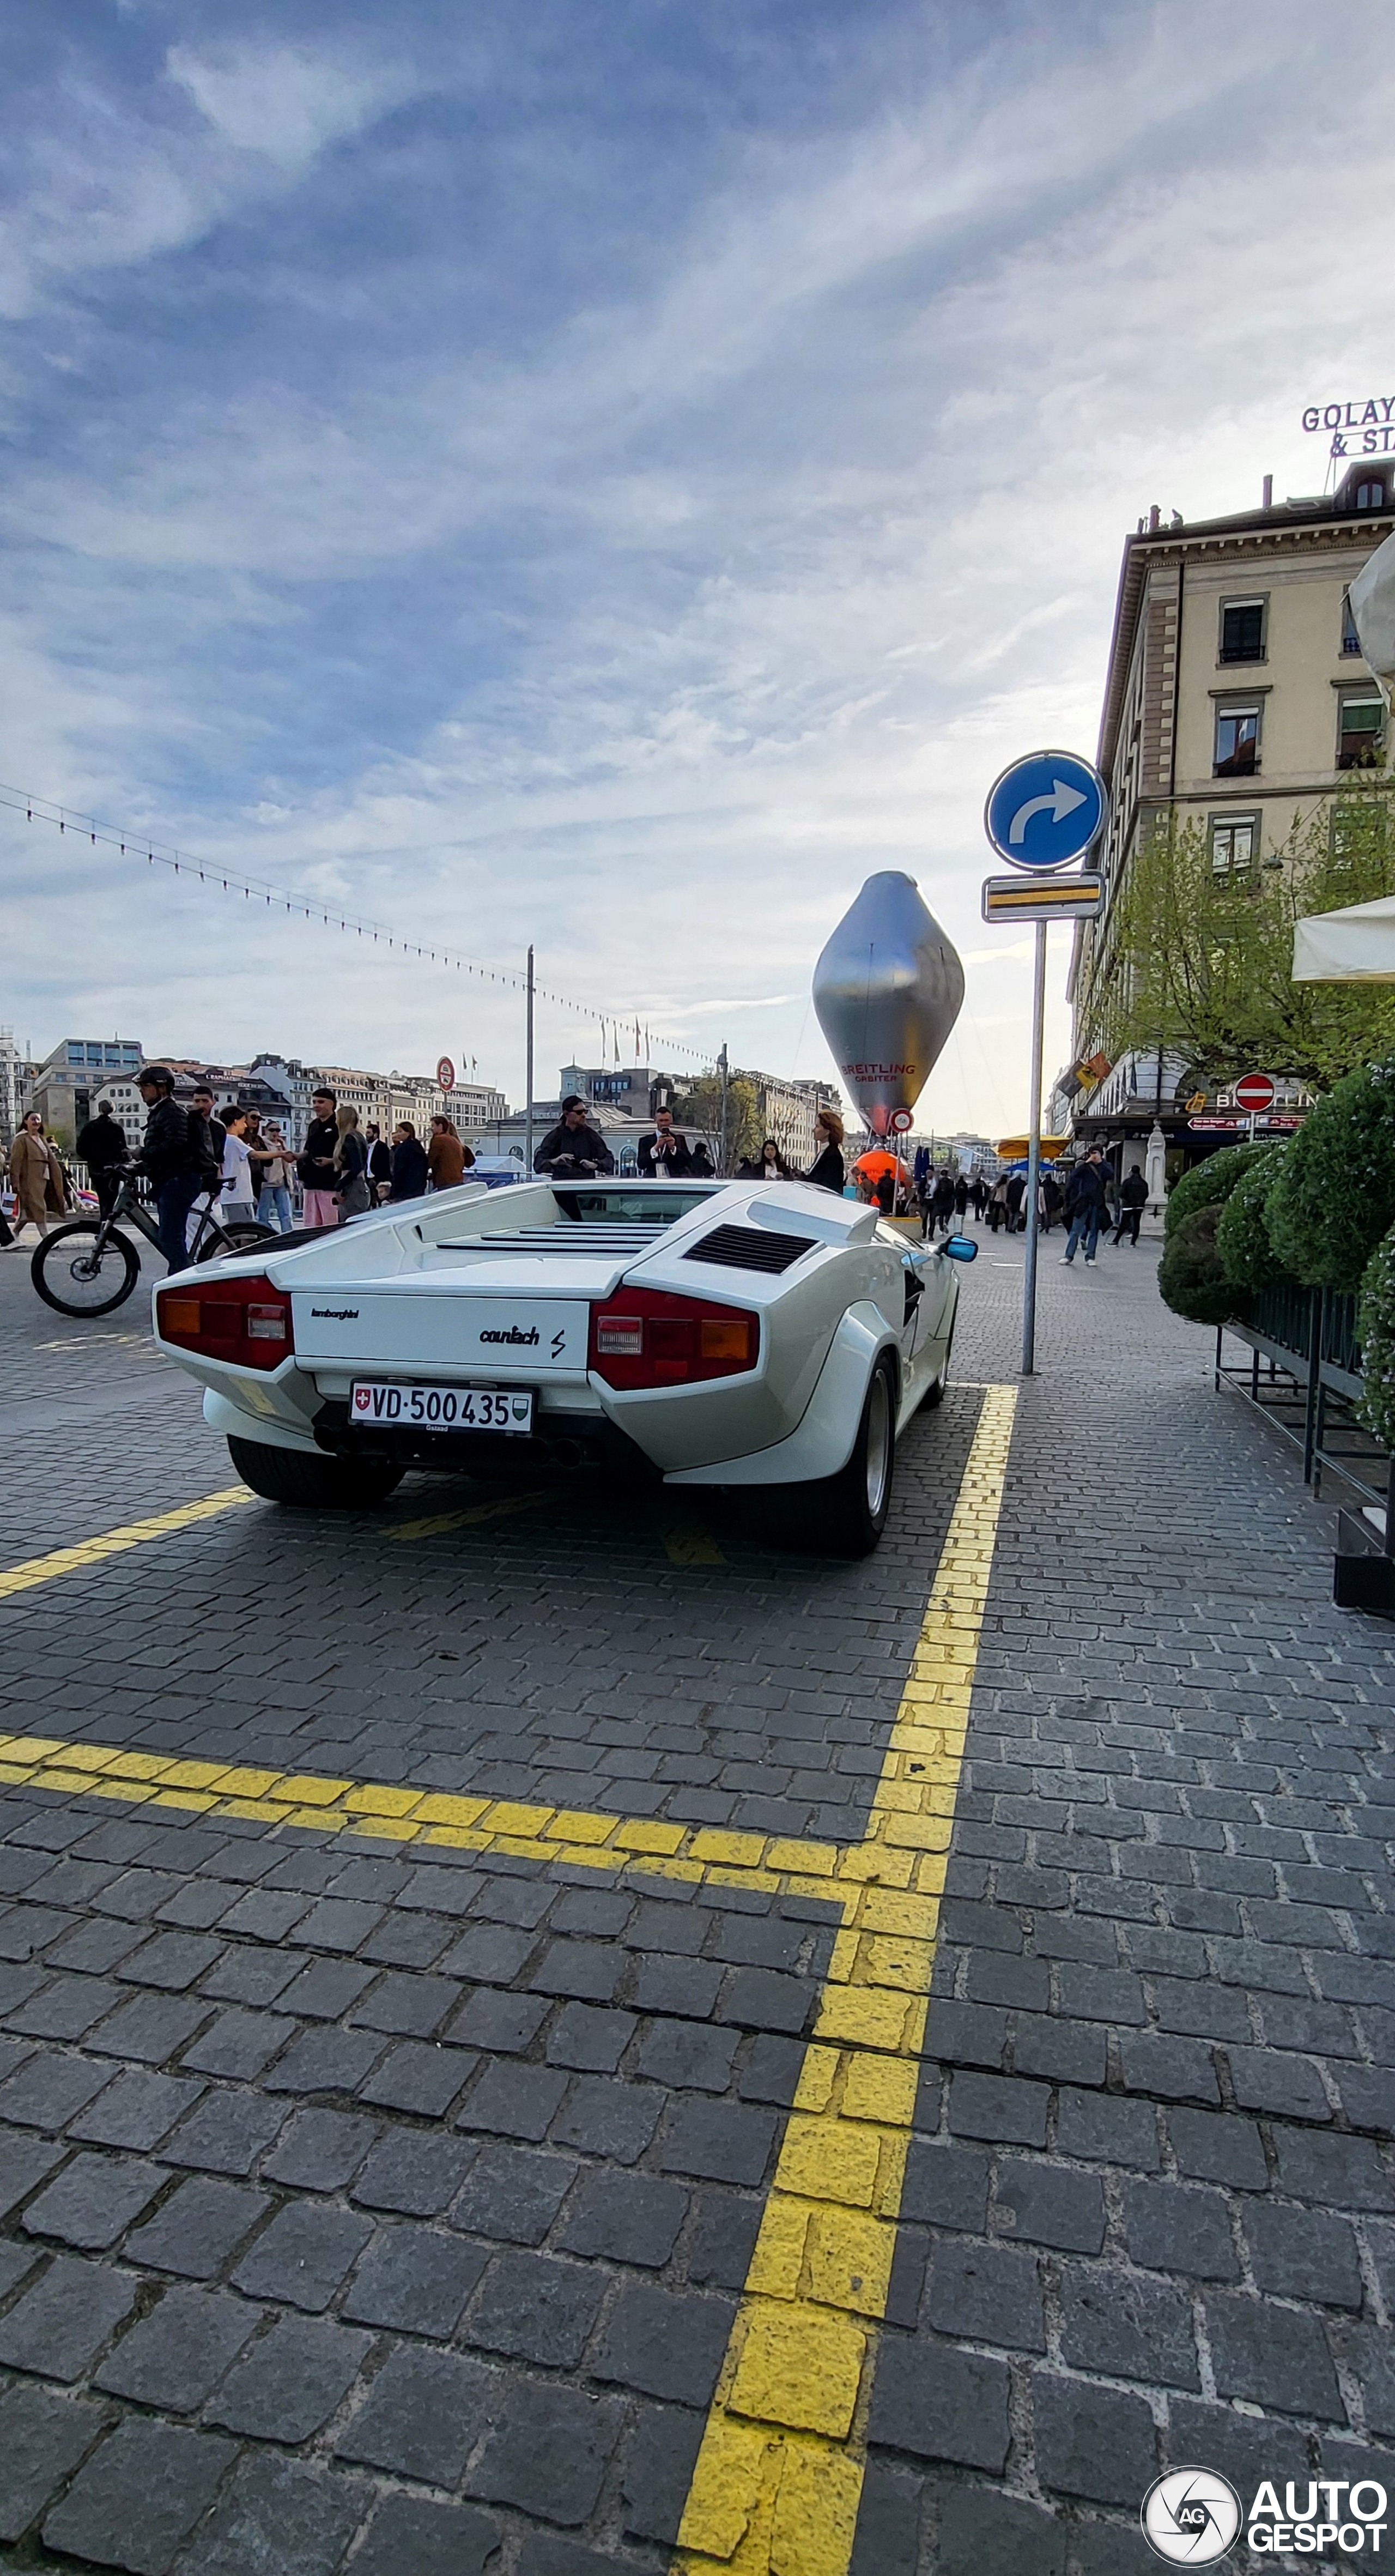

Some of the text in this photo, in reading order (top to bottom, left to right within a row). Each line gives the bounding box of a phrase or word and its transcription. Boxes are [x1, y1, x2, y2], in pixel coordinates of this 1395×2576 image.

[1303, 397, 1395, 431] GOLAY
[1330, 433, 1348, 457] &
[841, 1065, 915, 1075] BREITLING
[311, 1308, 359, 1320] lamborghini
[480, 1326, 566, 1359] countach S
